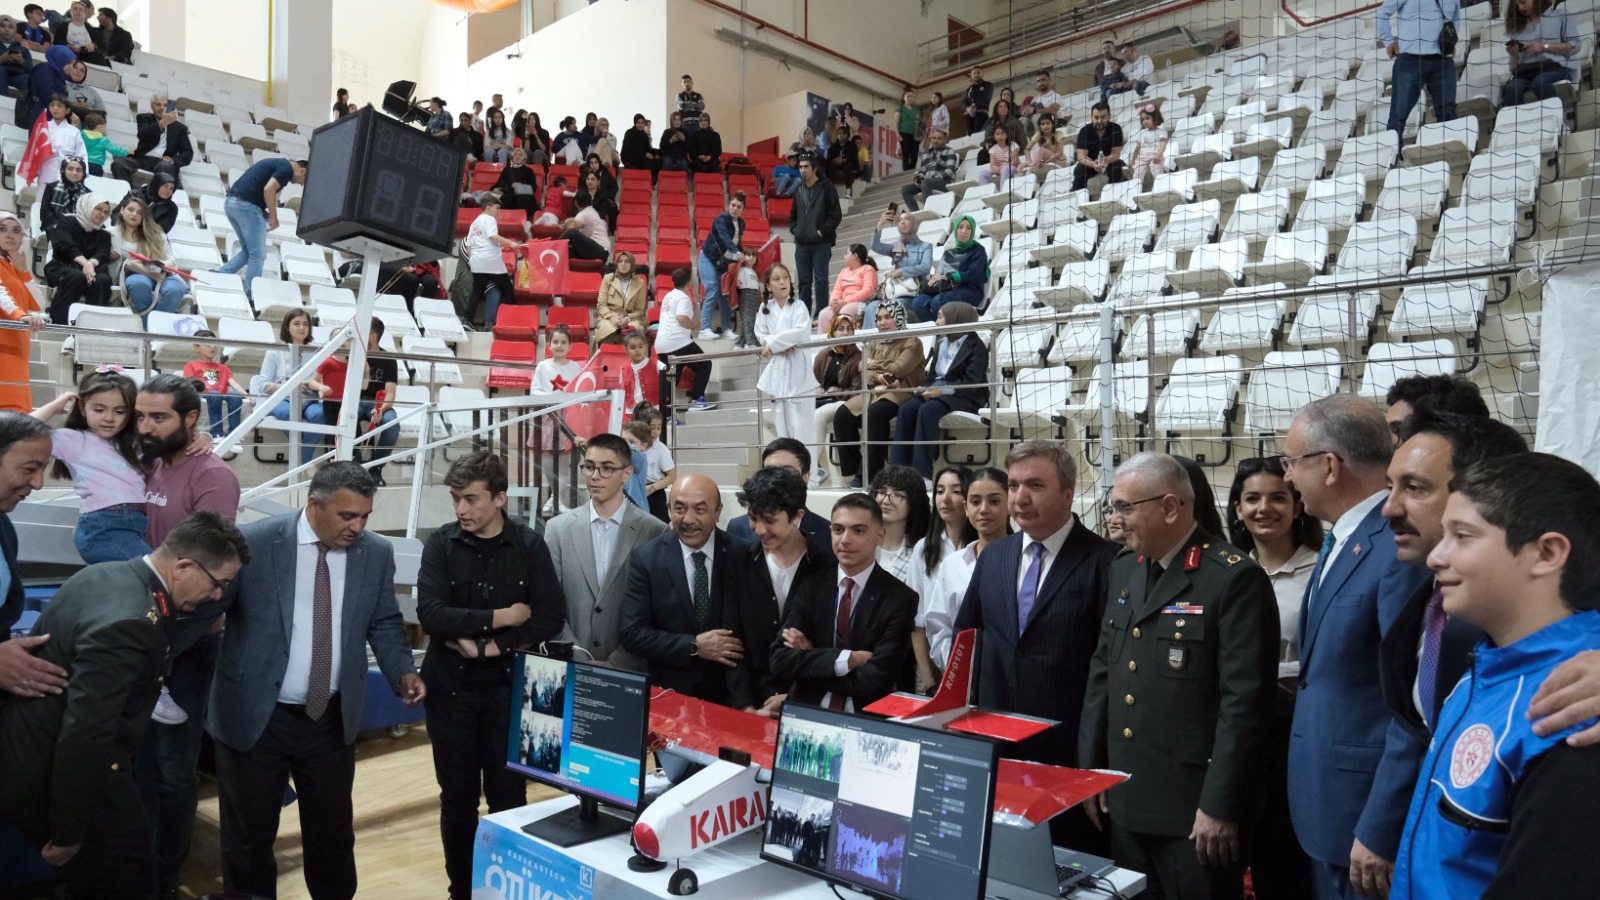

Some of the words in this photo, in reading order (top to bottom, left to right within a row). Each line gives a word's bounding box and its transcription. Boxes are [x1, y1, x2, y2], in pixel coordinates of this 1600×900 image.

[690, 786, 770, 849] KARA
[485, 853, 566, 900] ÖTÜ
[508, 850, 565, 883] KARAKASTECH
